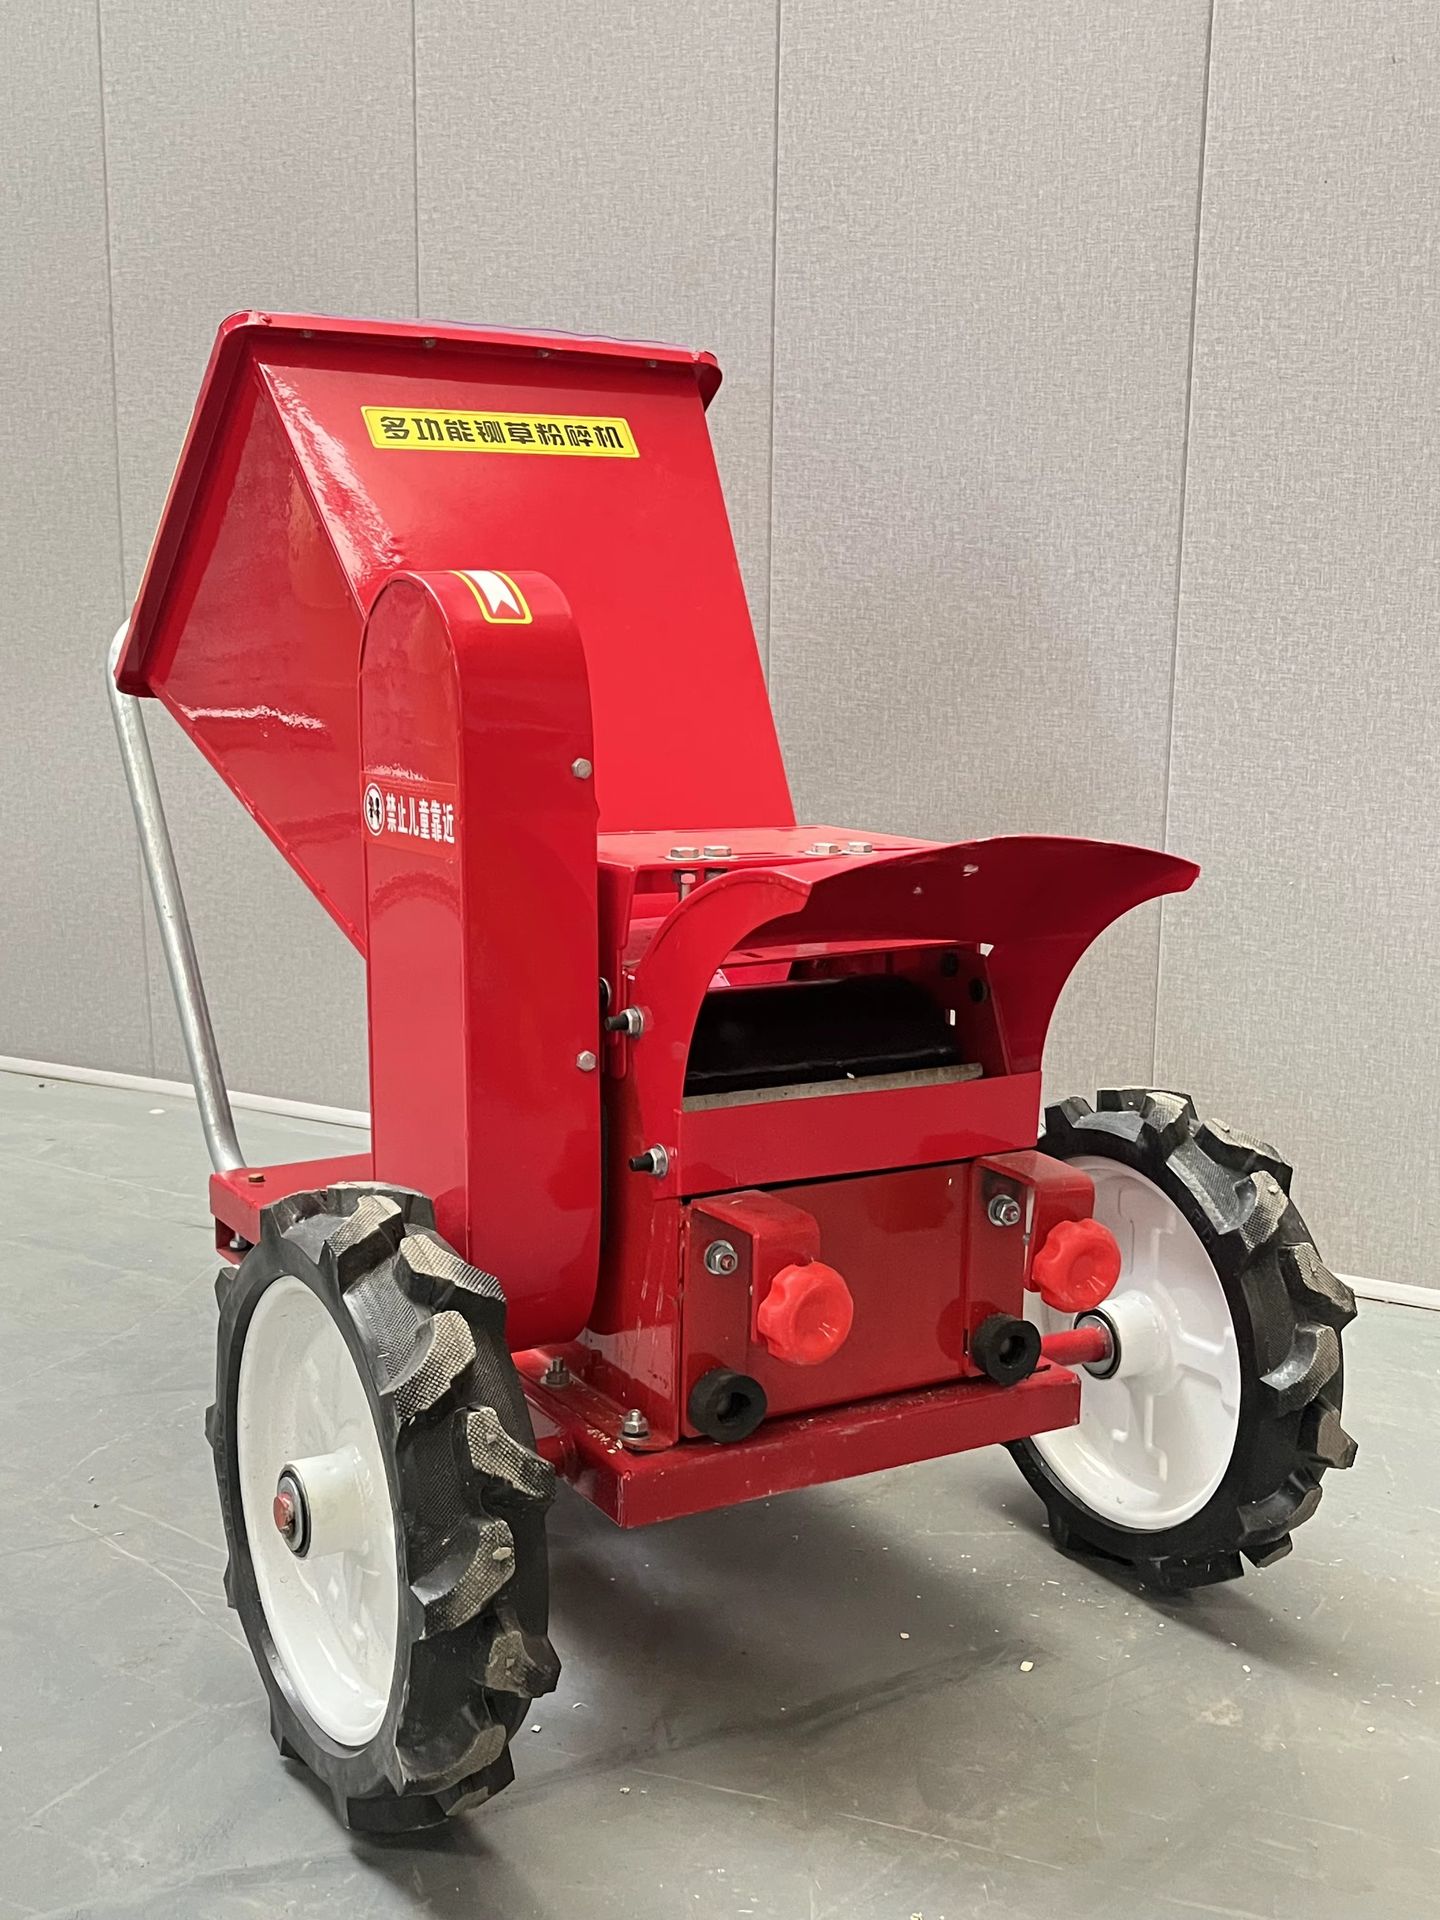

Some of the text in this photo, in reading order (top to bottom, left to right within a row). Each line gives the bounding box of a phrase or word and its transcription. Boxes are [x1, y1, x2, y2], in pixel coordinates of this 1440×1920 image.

[380, 416, 624, 448] 多功能铡草粉碎机
[386, 792, 455, 844] 禁止儿童靠近
